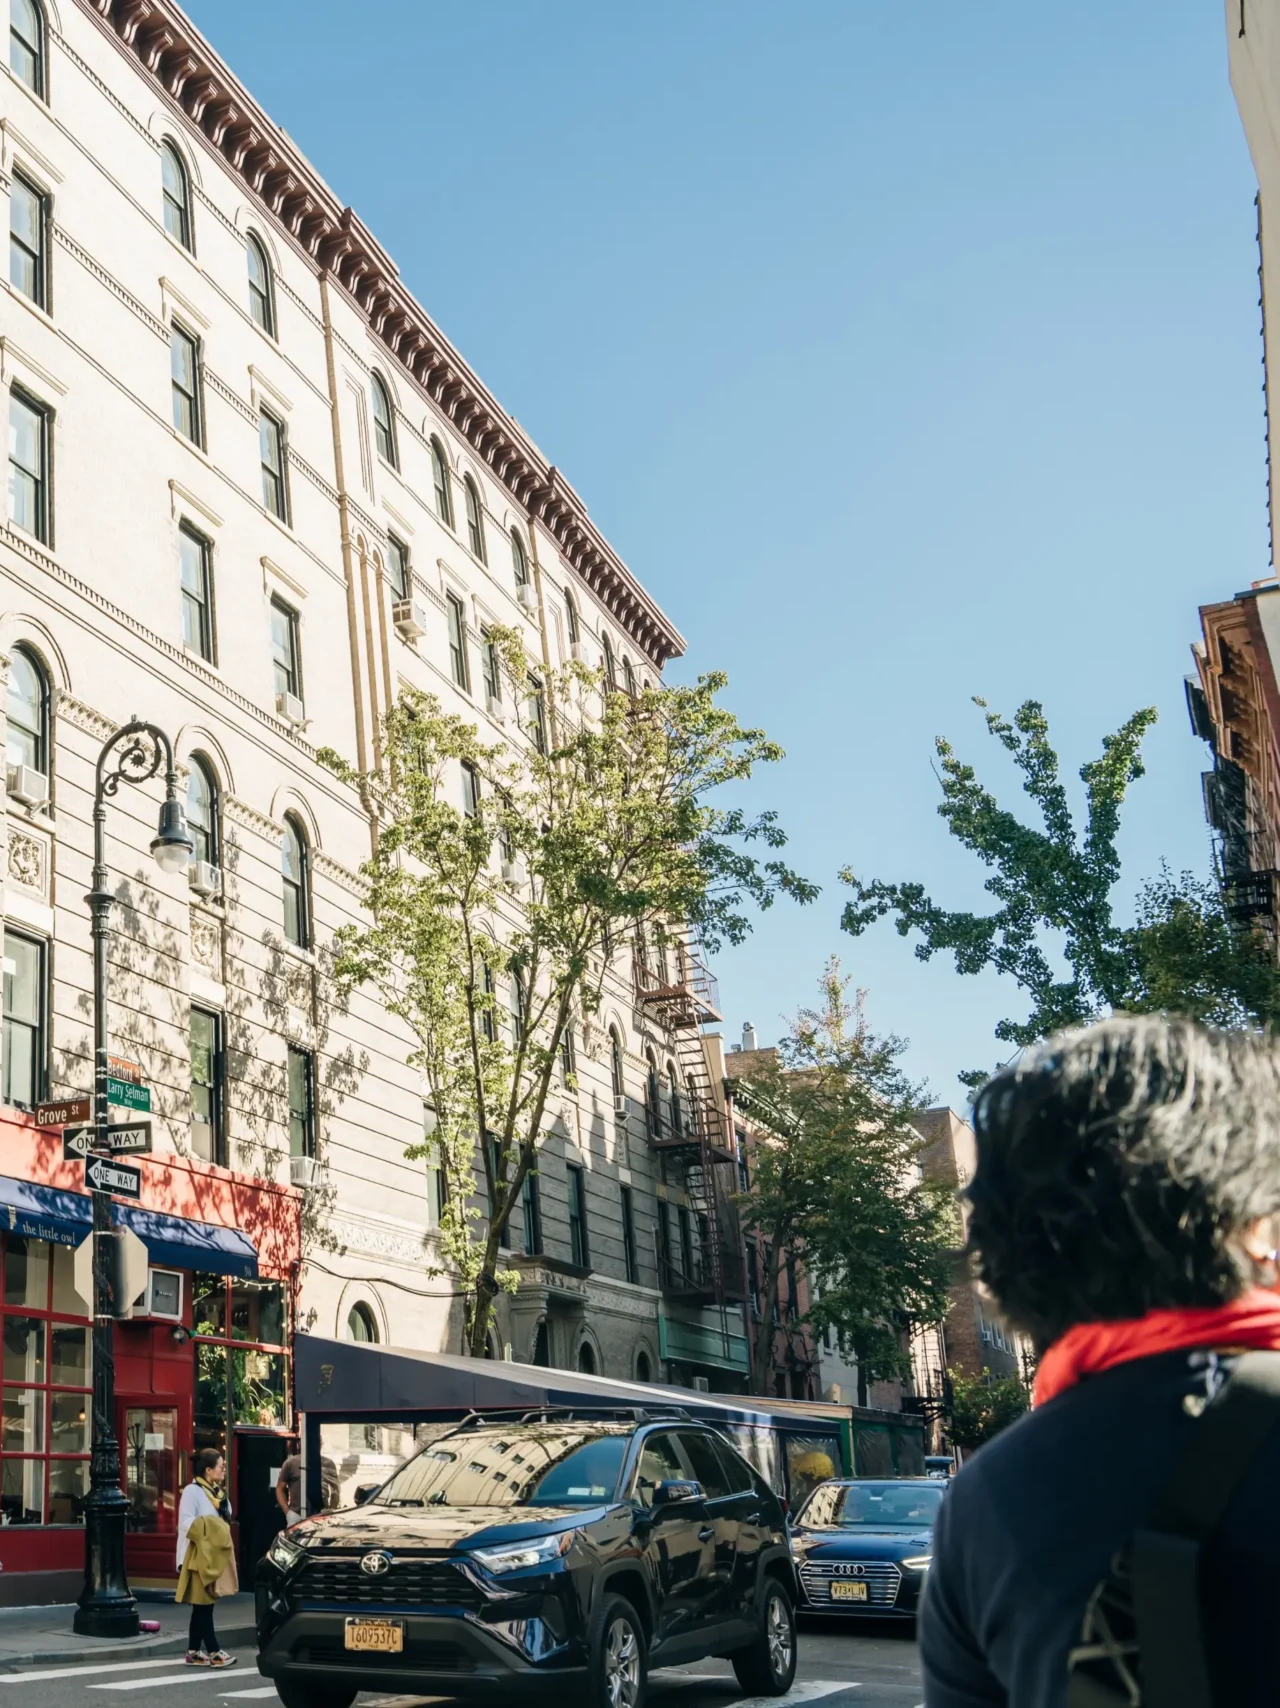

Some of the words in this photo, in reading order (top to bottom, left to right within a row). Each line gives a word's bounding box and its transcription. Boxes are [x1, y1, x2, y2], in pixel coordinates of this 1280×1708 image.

[108, 1080, 124, 1099] Larry
[125, 1085, 149, 1103] Selman
[38, 1109, 67, 1125] Grove
[71, 1104, 79, 1115] St
[76, 1136, 94, 1150] ON
[113, 1132, 140, 1147] WAY
[93, 1167, 110, 1183] ONE
[117, 1173, 134, 1189] WAY
[22, 1220, 36, 1235] the
[39, 1223, 58, 1240] little
[61, 1231, 75, 1245] owl
[350, 1627, 398, 1645] T609537C
